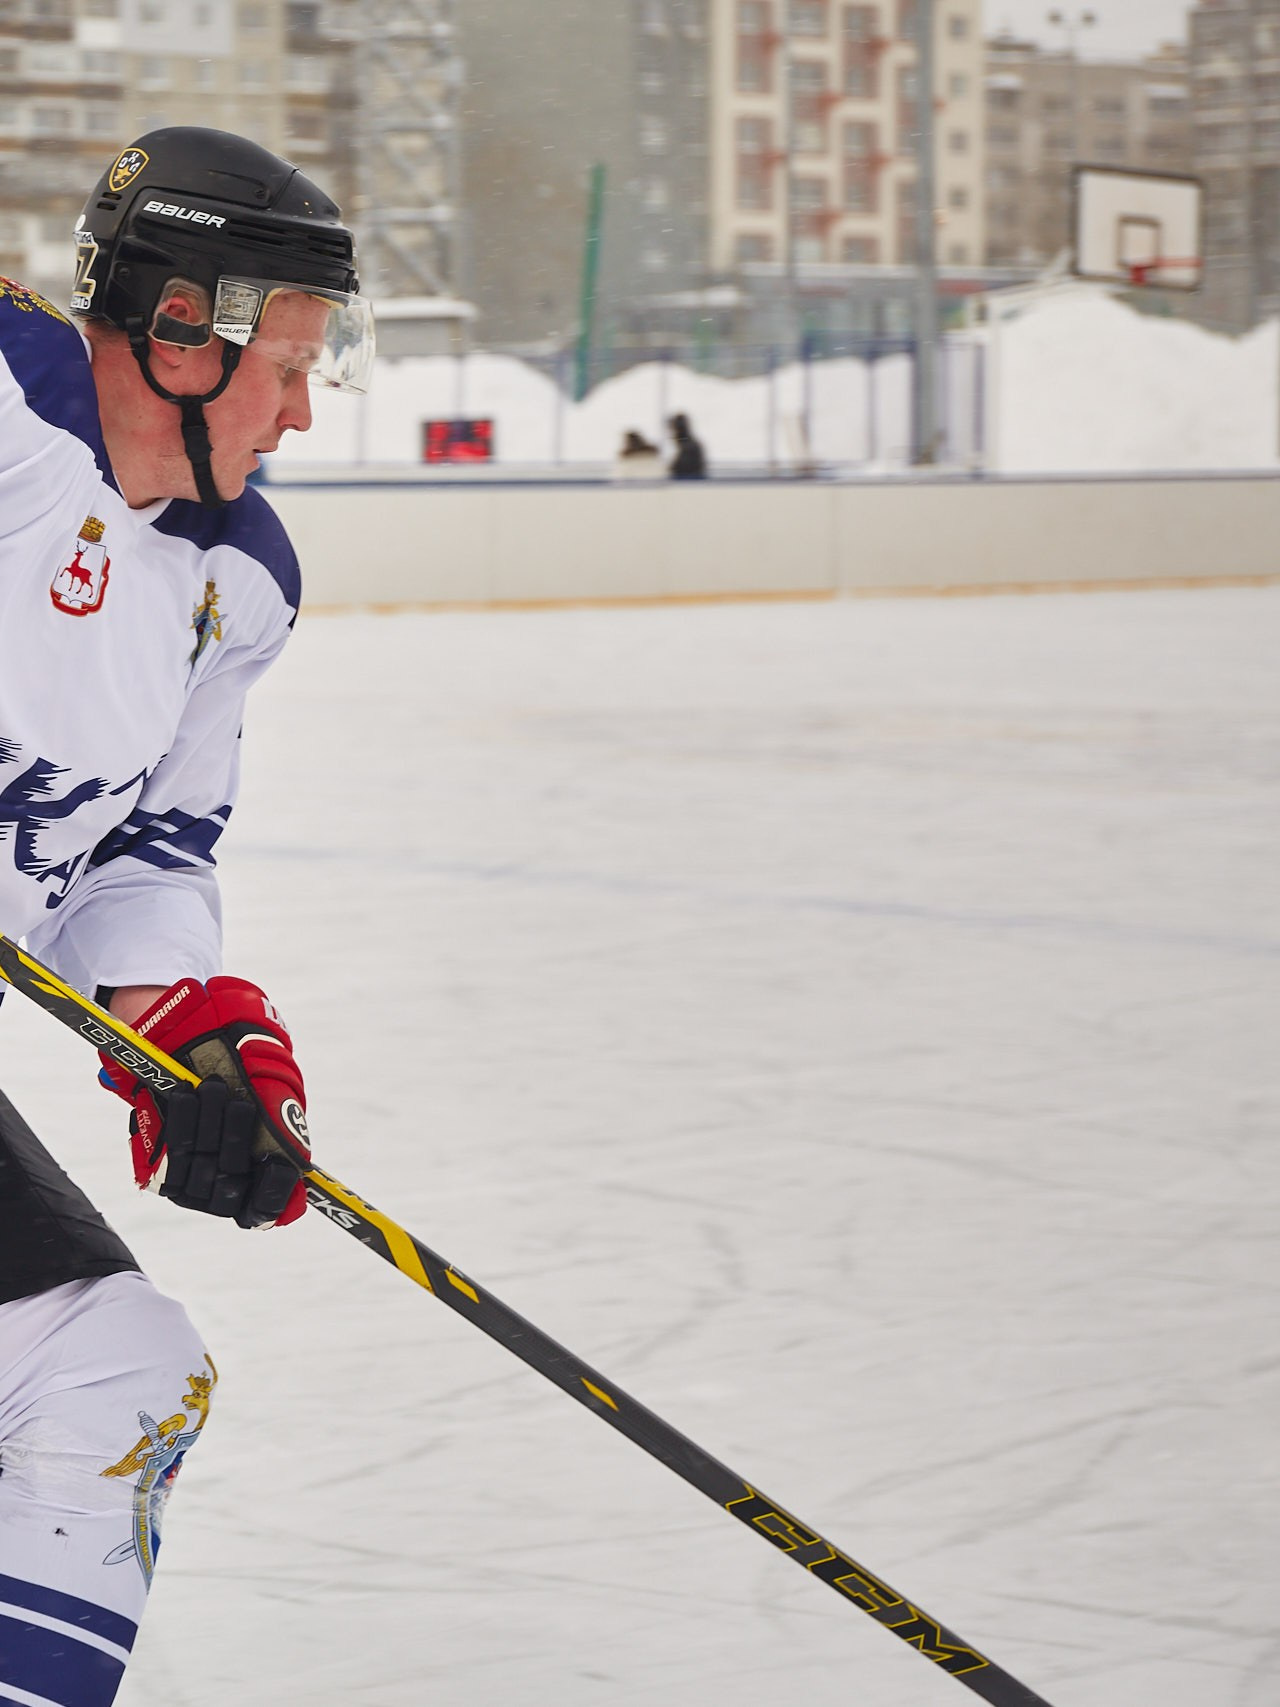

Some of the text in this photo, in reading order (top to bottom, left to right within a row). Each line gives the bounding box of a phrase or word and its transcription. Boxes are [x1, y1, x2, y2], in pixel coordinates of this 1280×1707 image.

[137, 984, 191, 1037] WARRIOR
[79, 1016, 178, 1091] CCM
[725, 1480, 990, 1675] CCM
